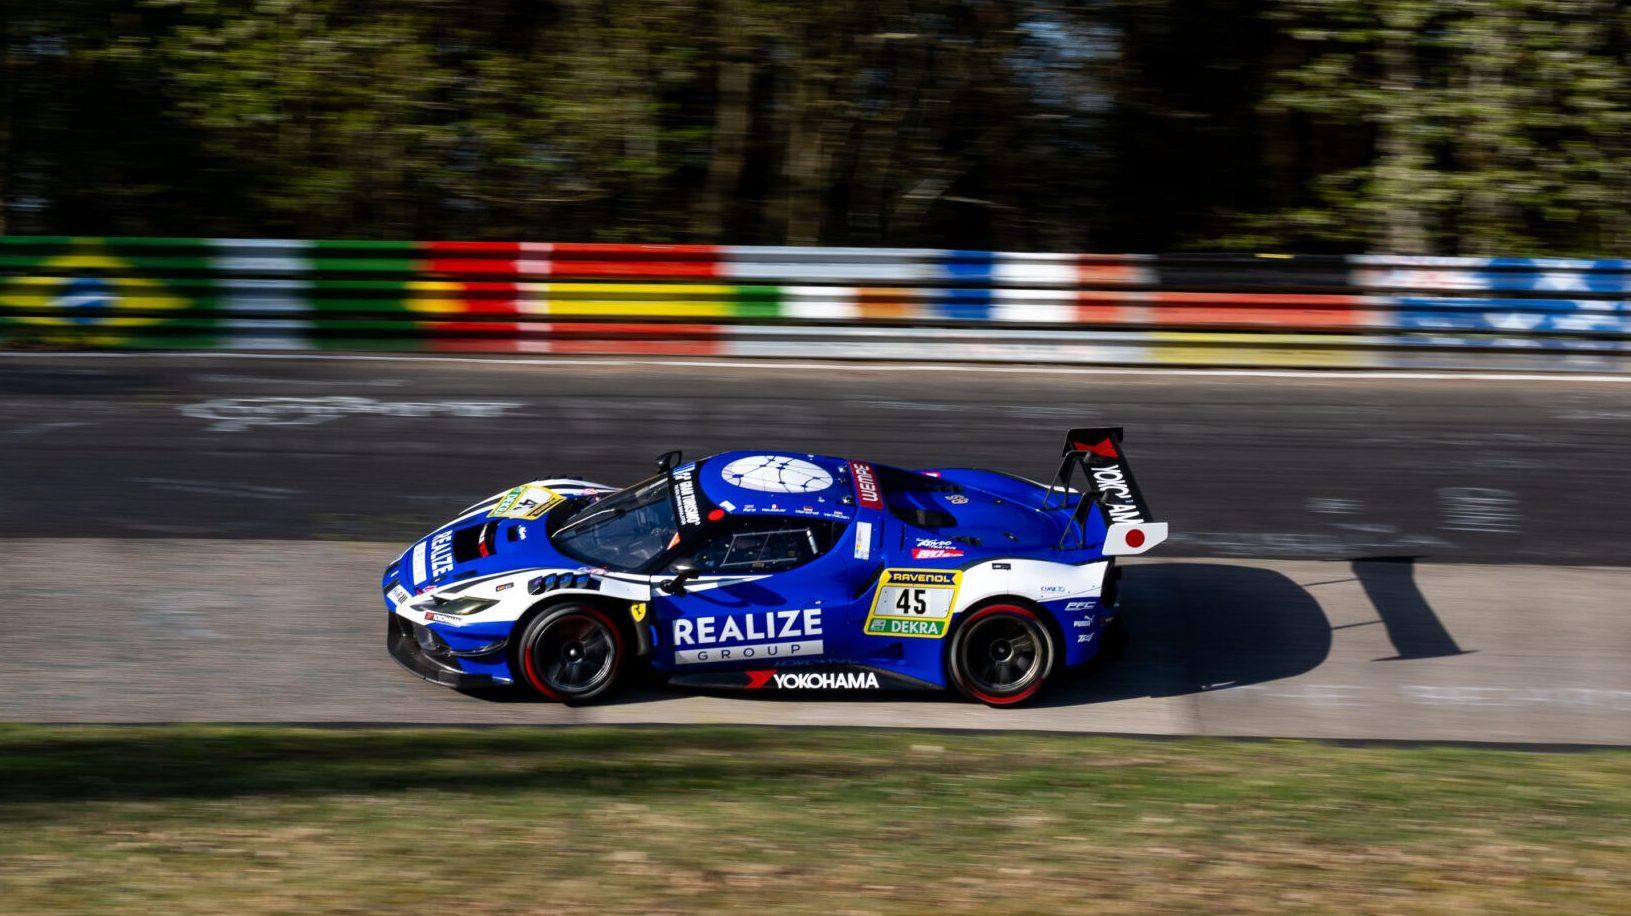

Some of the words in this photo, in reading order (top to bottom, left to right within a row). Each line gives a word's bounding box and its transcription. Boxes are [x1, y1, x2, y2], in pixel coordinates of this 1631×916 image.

[853, 462, 879, 503] WEMPE
[1090, 464, 1145, 524] YOKOAM
[430, 529, 454, 577] REALIZE
[893, 573, 951, 584] RAVENOL
[896, 589, 927, 615] 45
[674, 608, 823, 646] REALIZE
[891, 620, 939, 635] DEKRA
[697, 644, 801, 662] GROUP
[773, 671, 880, 689] YOKOHAMA
